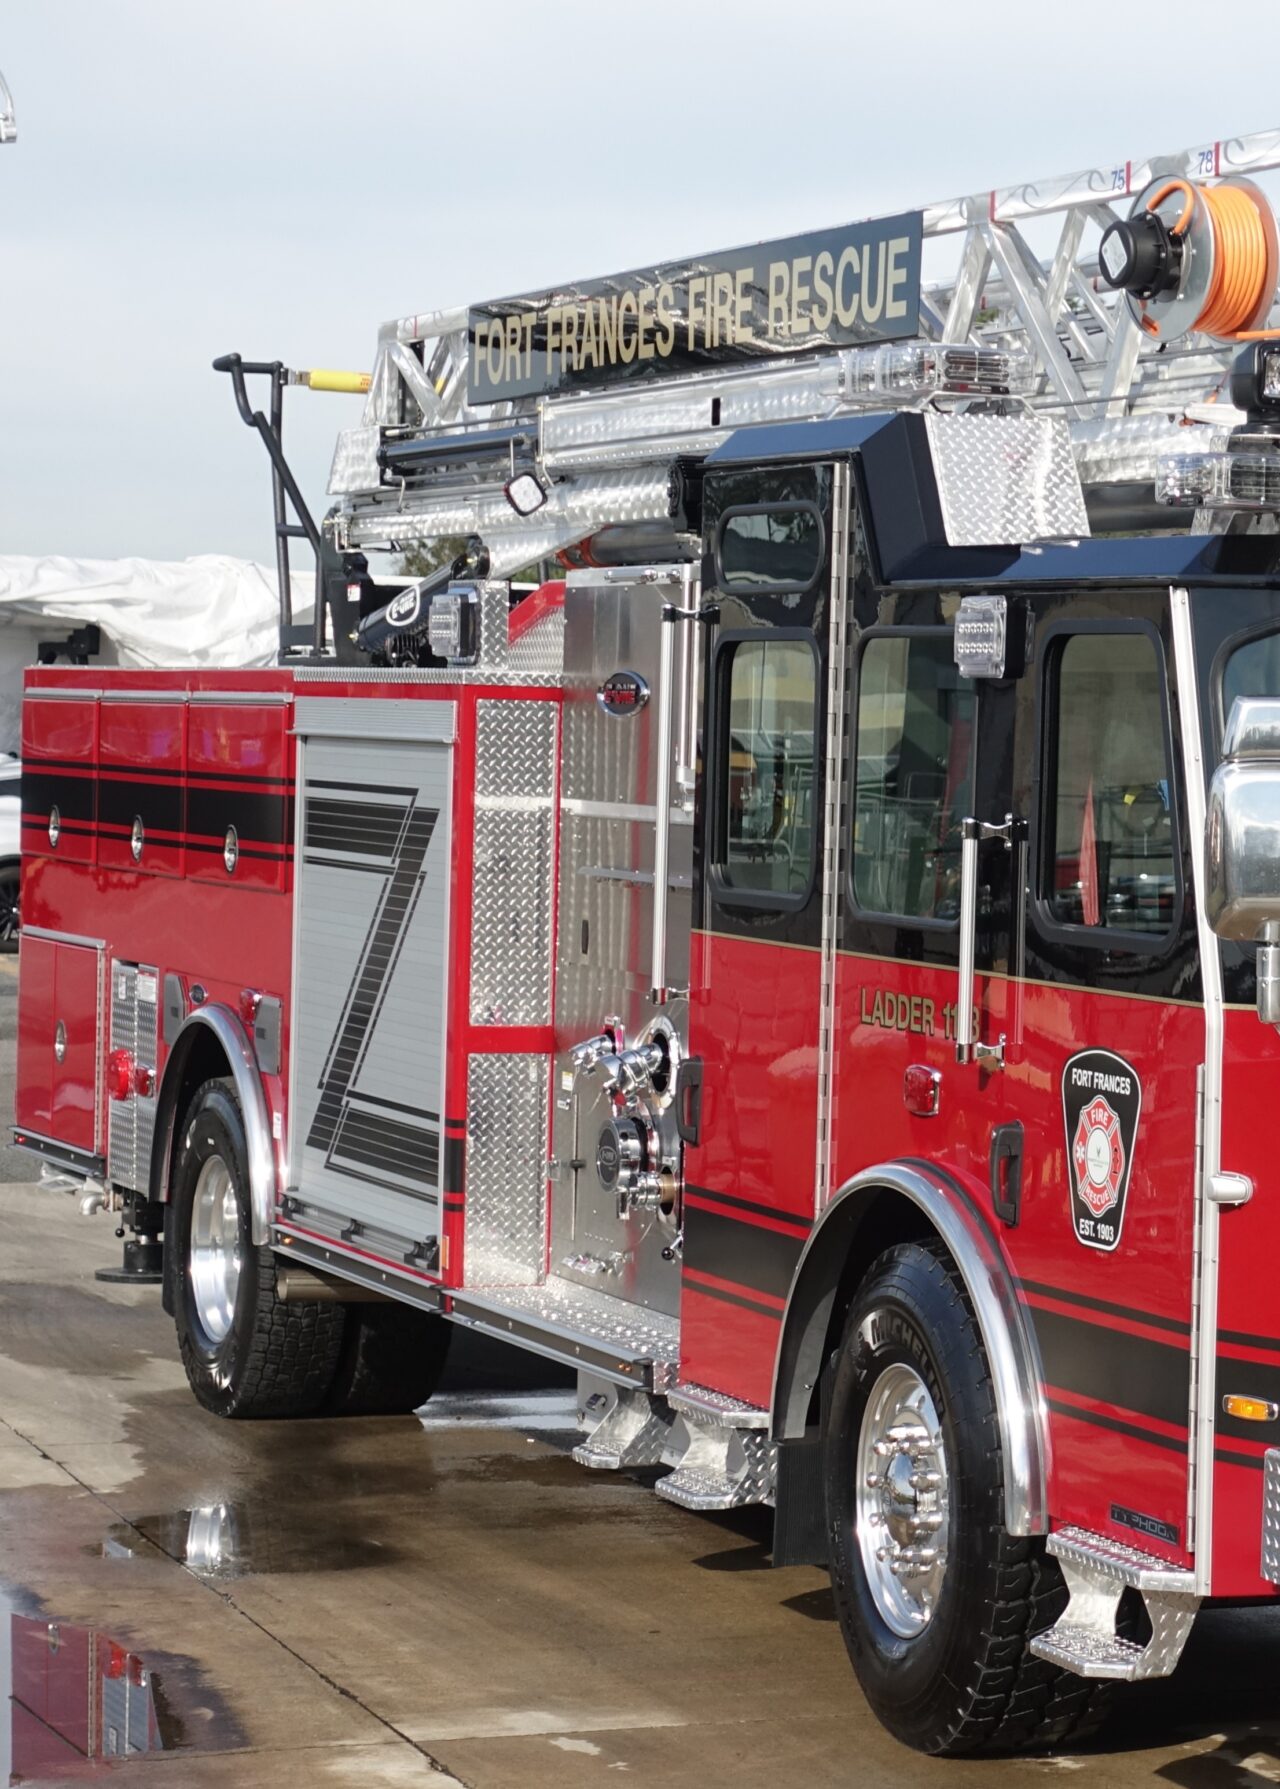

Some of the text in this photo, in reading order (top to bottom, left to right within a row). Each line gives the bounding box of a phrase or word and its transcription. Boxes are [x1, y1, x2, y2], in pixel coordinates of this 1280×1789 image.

[1198, 149, 1213, 175] 78
[1111, 168, 1125, 191] 75
[474, 236, 910, 387] FORT FRANCES FIRE RESCUE
[861, 987, 935, 1036] LADDER
[1071, 1067, 1131, 1096] FORT FRANCES
[1090, 1107, 1109, 1127] FIRE
[1085, 1184, 1110, 1206] RESCUE
[1079, 1218, 1115, 1242] EST. 1903
